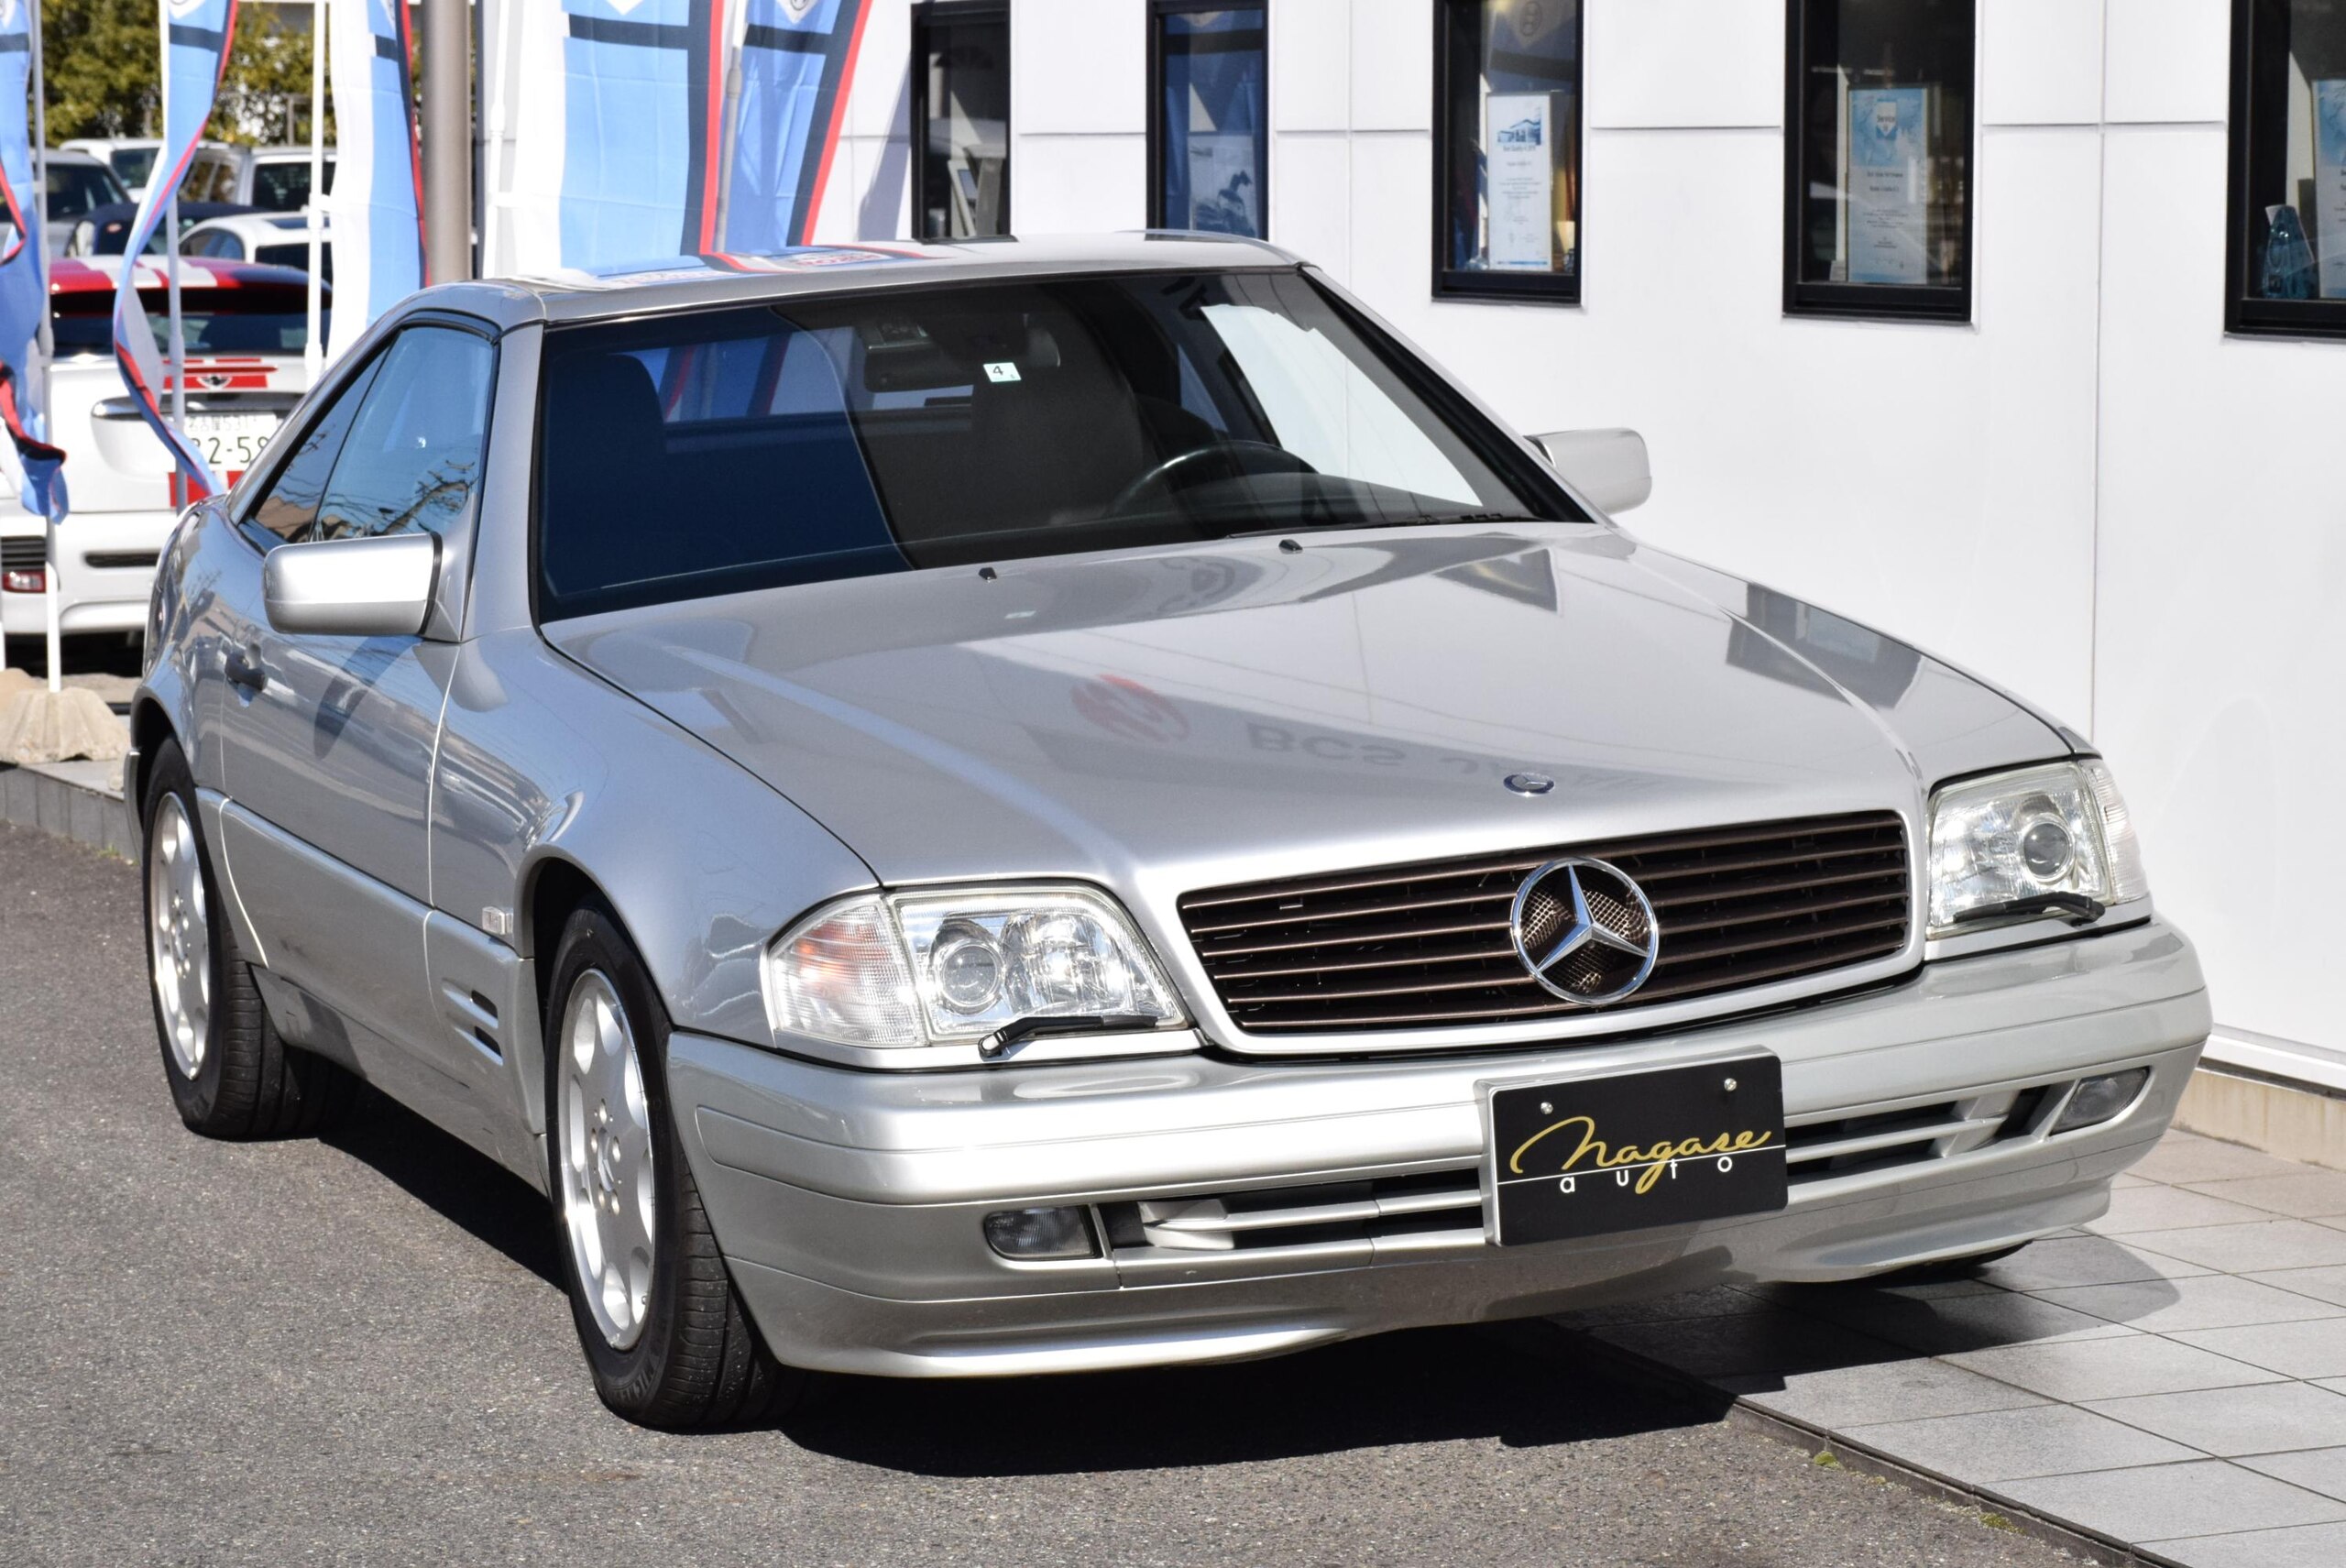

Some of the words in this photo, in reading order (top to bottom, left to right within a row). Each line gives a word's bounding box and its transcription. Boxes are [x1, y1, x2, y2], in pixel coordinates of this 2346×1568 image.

[992, 366, 1003, 376] 4
[1510, 1115, 1772, 1194] Nagase
[1560, 1156, 1734, 1193] auto
